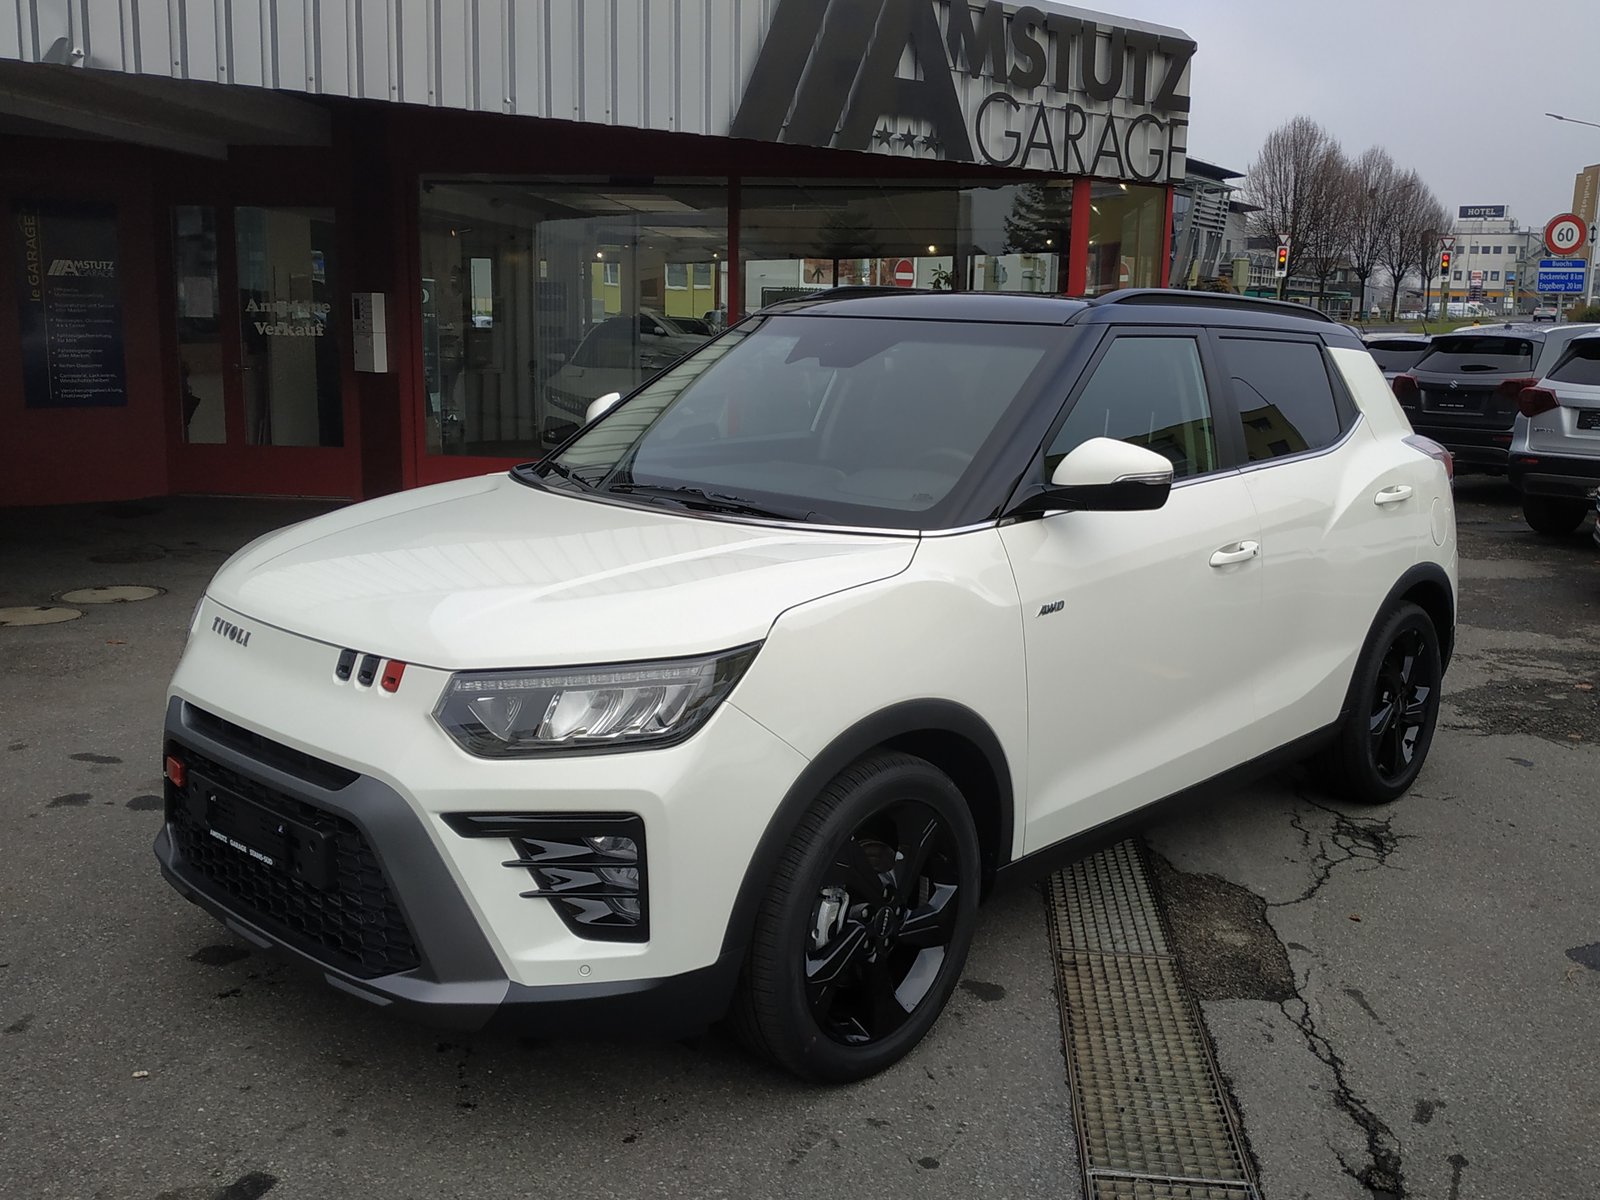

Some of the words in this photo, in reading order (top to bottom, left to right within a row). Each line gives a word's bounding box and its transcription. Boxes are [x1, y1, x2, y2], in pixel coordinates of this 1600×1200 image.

[832, 0, 1197, 162] AMSTUTZ
[975, 92, 1190, 183] GARAGE
[1467, 208, 1496, 216] HOTEL
[1557, 228, 1574, 242] 60
[24, 215, 40, 286] GARAGE
[56, 259, 114, 276] AMSTUTZ
[1539, 282, 1565, 290] Engelberg
[253, 321, 325, 337] Verkauf
[1036, 600, 1065, 618] AWD
[212, 616, 252, 647] TIVOLI
